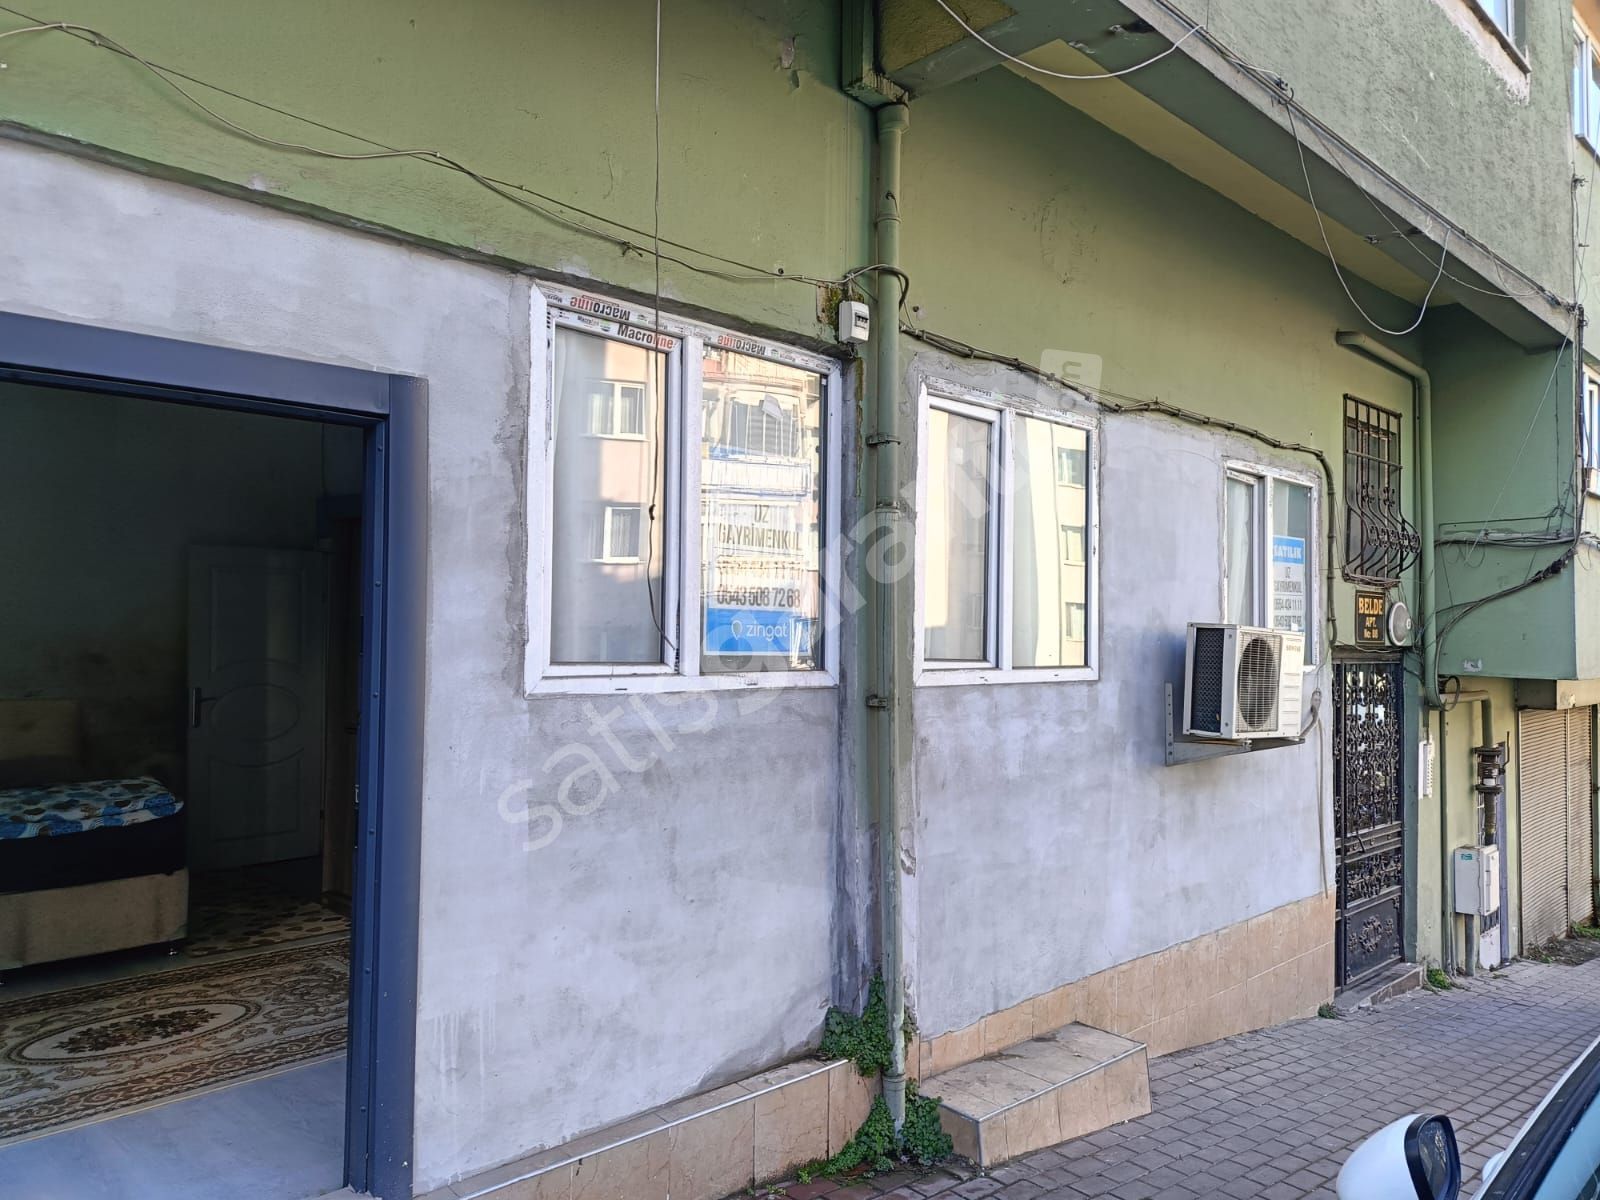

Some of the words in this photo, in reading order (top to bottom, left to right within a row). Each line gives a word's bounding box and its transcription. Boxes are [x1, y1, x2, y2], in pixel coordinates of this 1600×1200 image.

[570, 296, 631, 321] Macroline
[617, 323, 674, 349] Macroline
[717, 334, 766, 356] Macroline
[1358, 597, 1384, 616] BELDE
[746, 622, 790, 642] zingat
